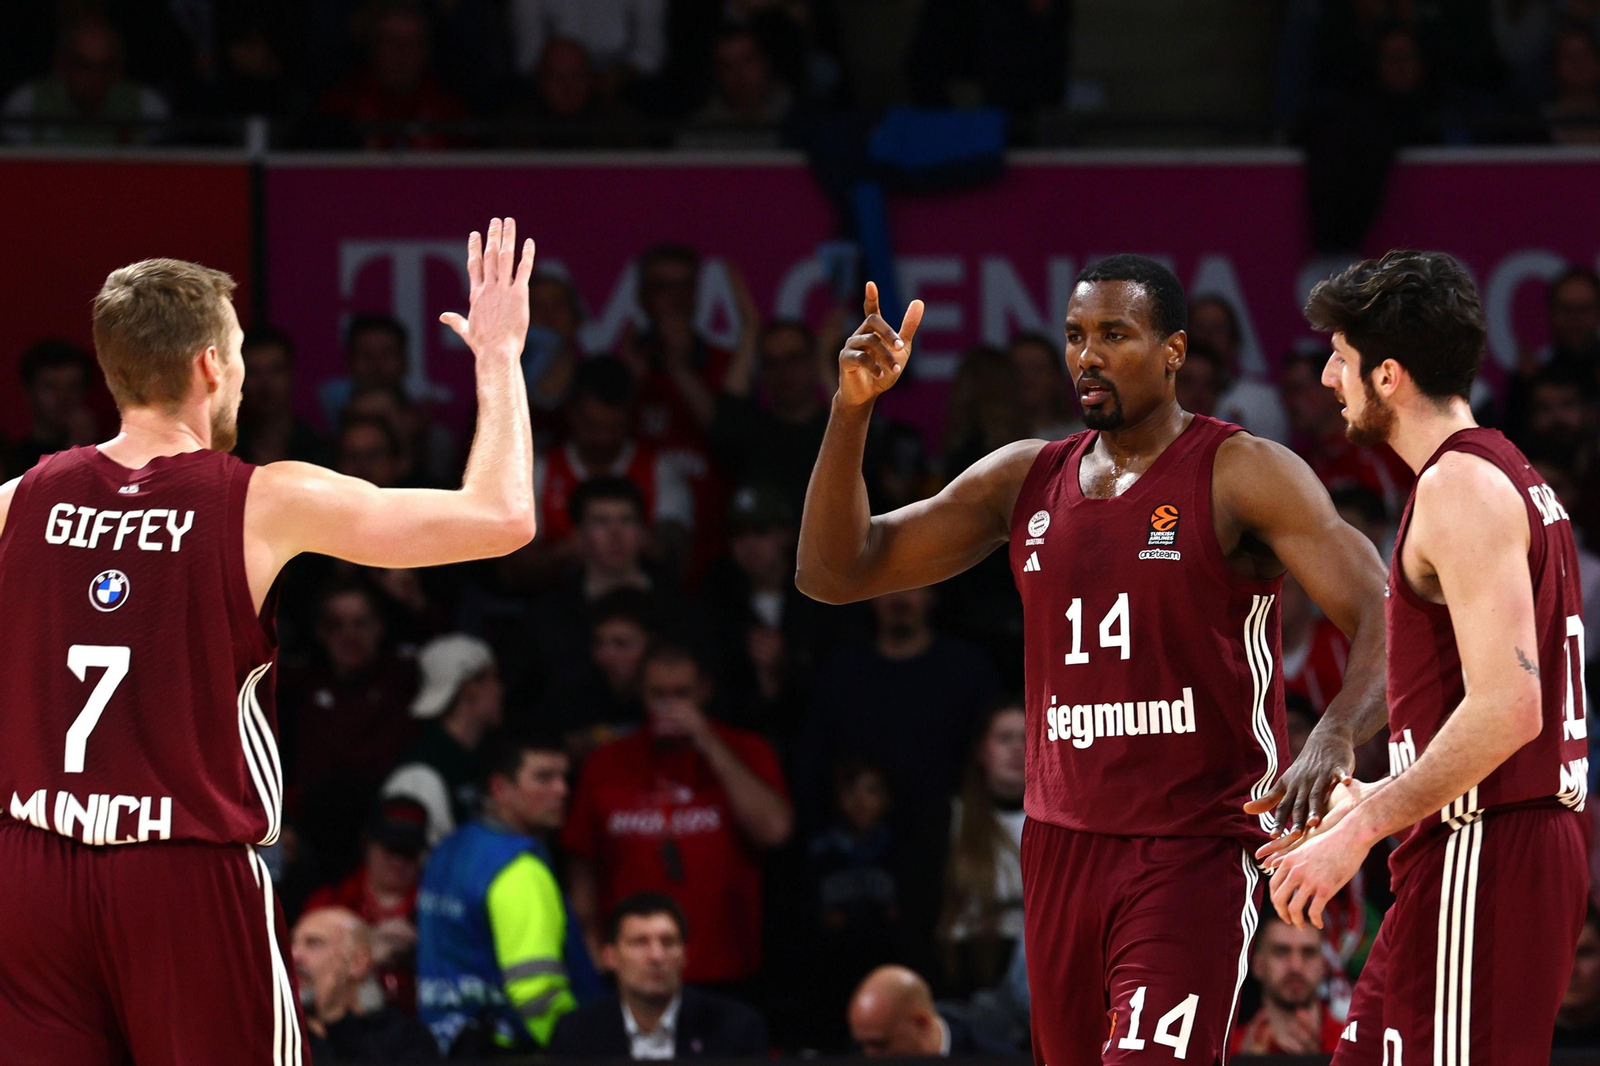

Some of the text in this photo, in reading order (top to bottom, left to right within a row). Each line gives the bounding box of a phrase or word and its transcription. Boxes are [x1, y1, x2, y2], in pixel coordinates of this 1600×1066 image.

[45, 502, 196, 553] GIFFEY
[1139, 549, 1181, 560] oneteam
[1064, 592, 1131, 666] 14
[64, 644, 131, 773] 7
[1047, 687, 1196, 749] siegmund
[10, 789, 172, 846] MUNICH
[1117, 986, 1200, 1060] 14
